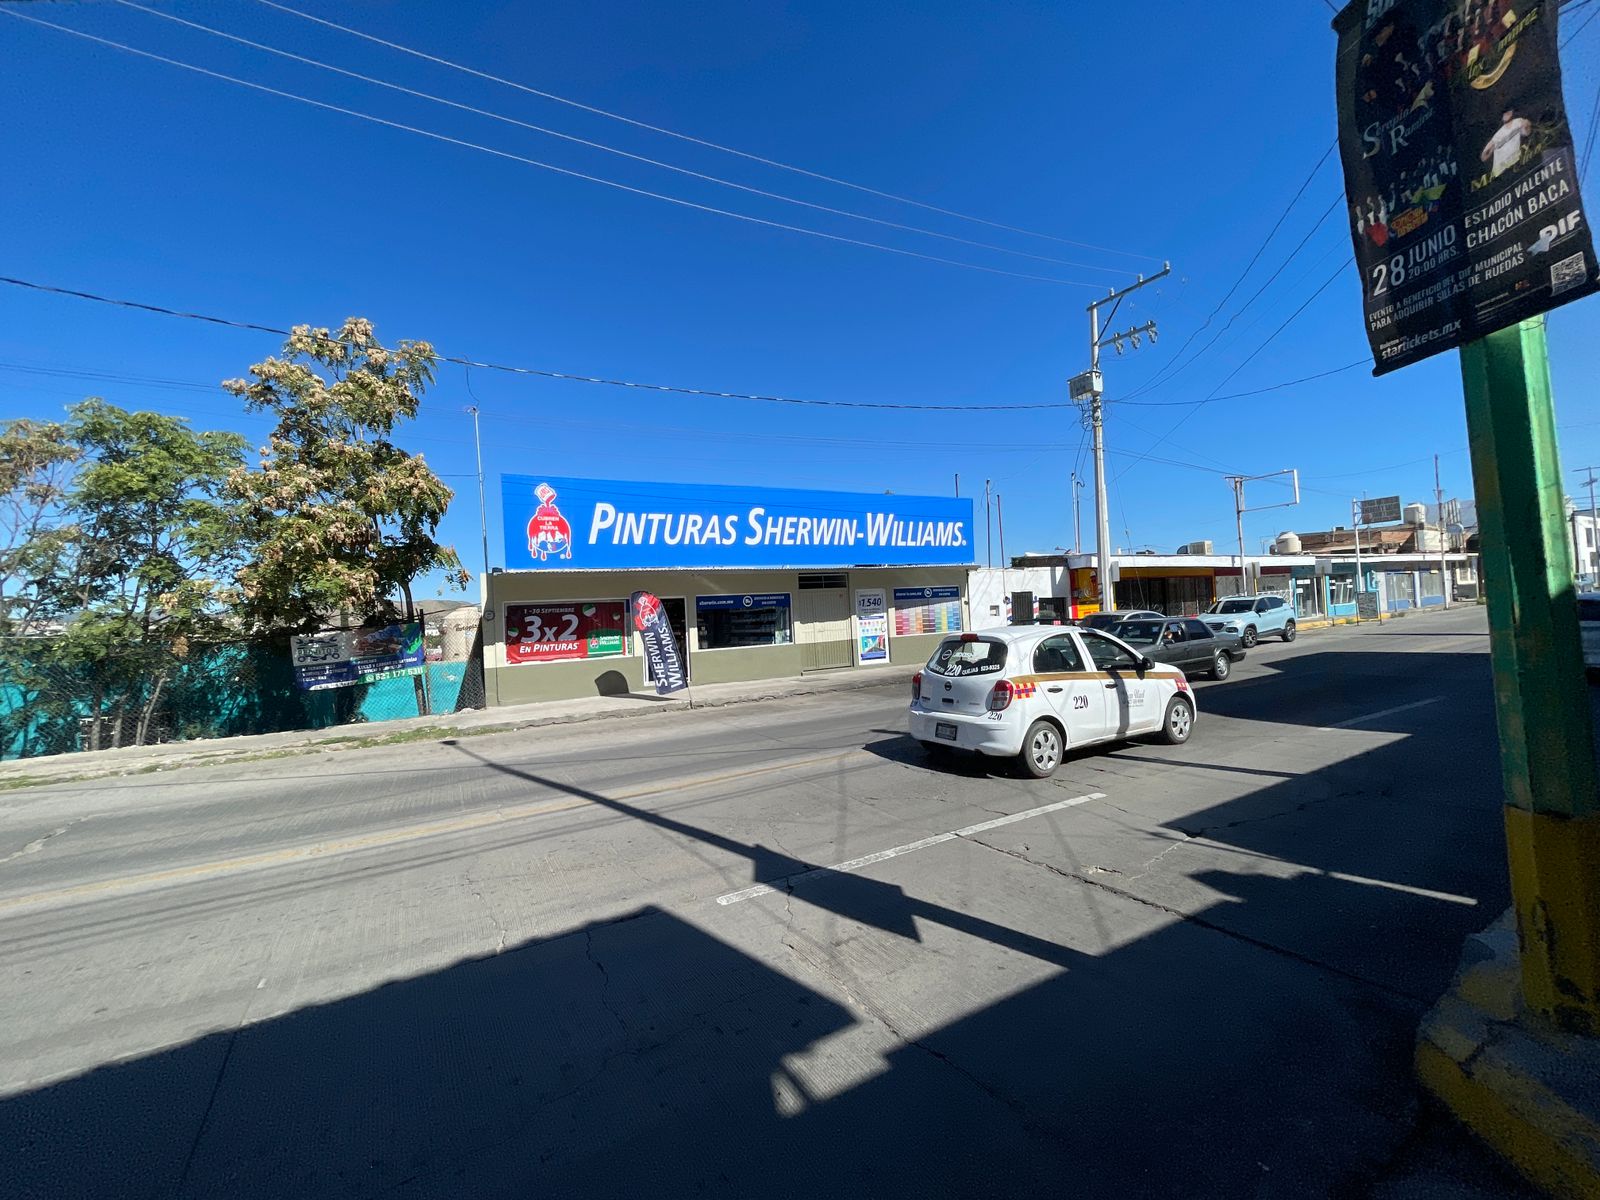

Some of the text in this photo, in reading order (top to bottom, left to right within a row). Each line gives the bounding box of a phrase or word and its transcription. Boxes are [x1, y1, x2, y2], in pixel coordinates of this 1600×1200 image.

[1465, 192, 1512, 228] ESTADIO
[1514, 157, 1564, 198] VALENTE
[1467, 205, 1523, 248] CHACÓN
[1527, 179, 1569, 214] BACA
[1539, 209, 1581, 242] DIF
[1372, 225, 1456, 297] 28 JUNIO
[1408, 258, 1436, 279] 20:00
[1369, 304, 1394, 322] EVENTO
[1396, 301, 1401, 310] A
[1403, 282, 1442, 306] BENEFICIO
[1458, 265, 1472, 280] DIF
[1475, 242, 1523, 272] MUNICIPAL
[1371, 315, 1392, 331] PARA
[1394, 296, 1434, 321] ADQUIRIR
[1436, 280, 1465, 302] SILLAS
[1468, 273, 1480, 288] DE
[1485, 252, 1524, 280] RUEDAS
[1381, 319, 1462, 360] startickets.mx
[588, 502, 738, 546] PINTURAS
[520, 614, 579, 643] 3x2
[520, 645, 531, 653] EN
[644, 632, 668, 687] SHERWIN
[944, 664, 962, 677] 220
[988, 711, 1002, 721] 220
[1073, 694, 1089, 709] 220
